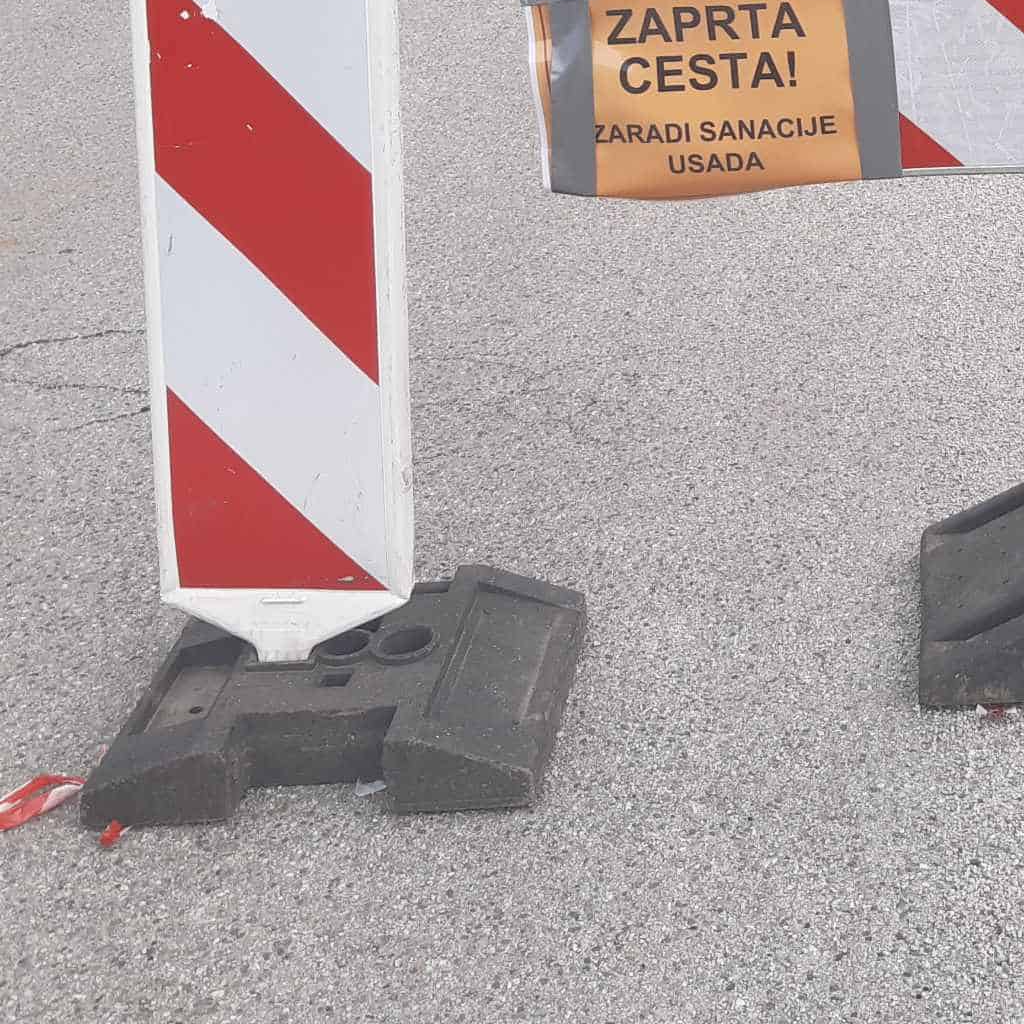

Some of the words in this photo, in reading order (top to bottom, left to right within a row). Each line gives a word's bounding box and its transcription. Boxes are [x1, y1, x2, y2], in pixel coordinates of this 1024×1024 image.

[605, 1, 806, 45] ZAPRTA
[619, 50, 798, 94] CESTA!
[594, 122, 691, 144] ZARADI
[699, 115, 838, 142] SANACIJE
[668, 151, 765, 174] USADA
